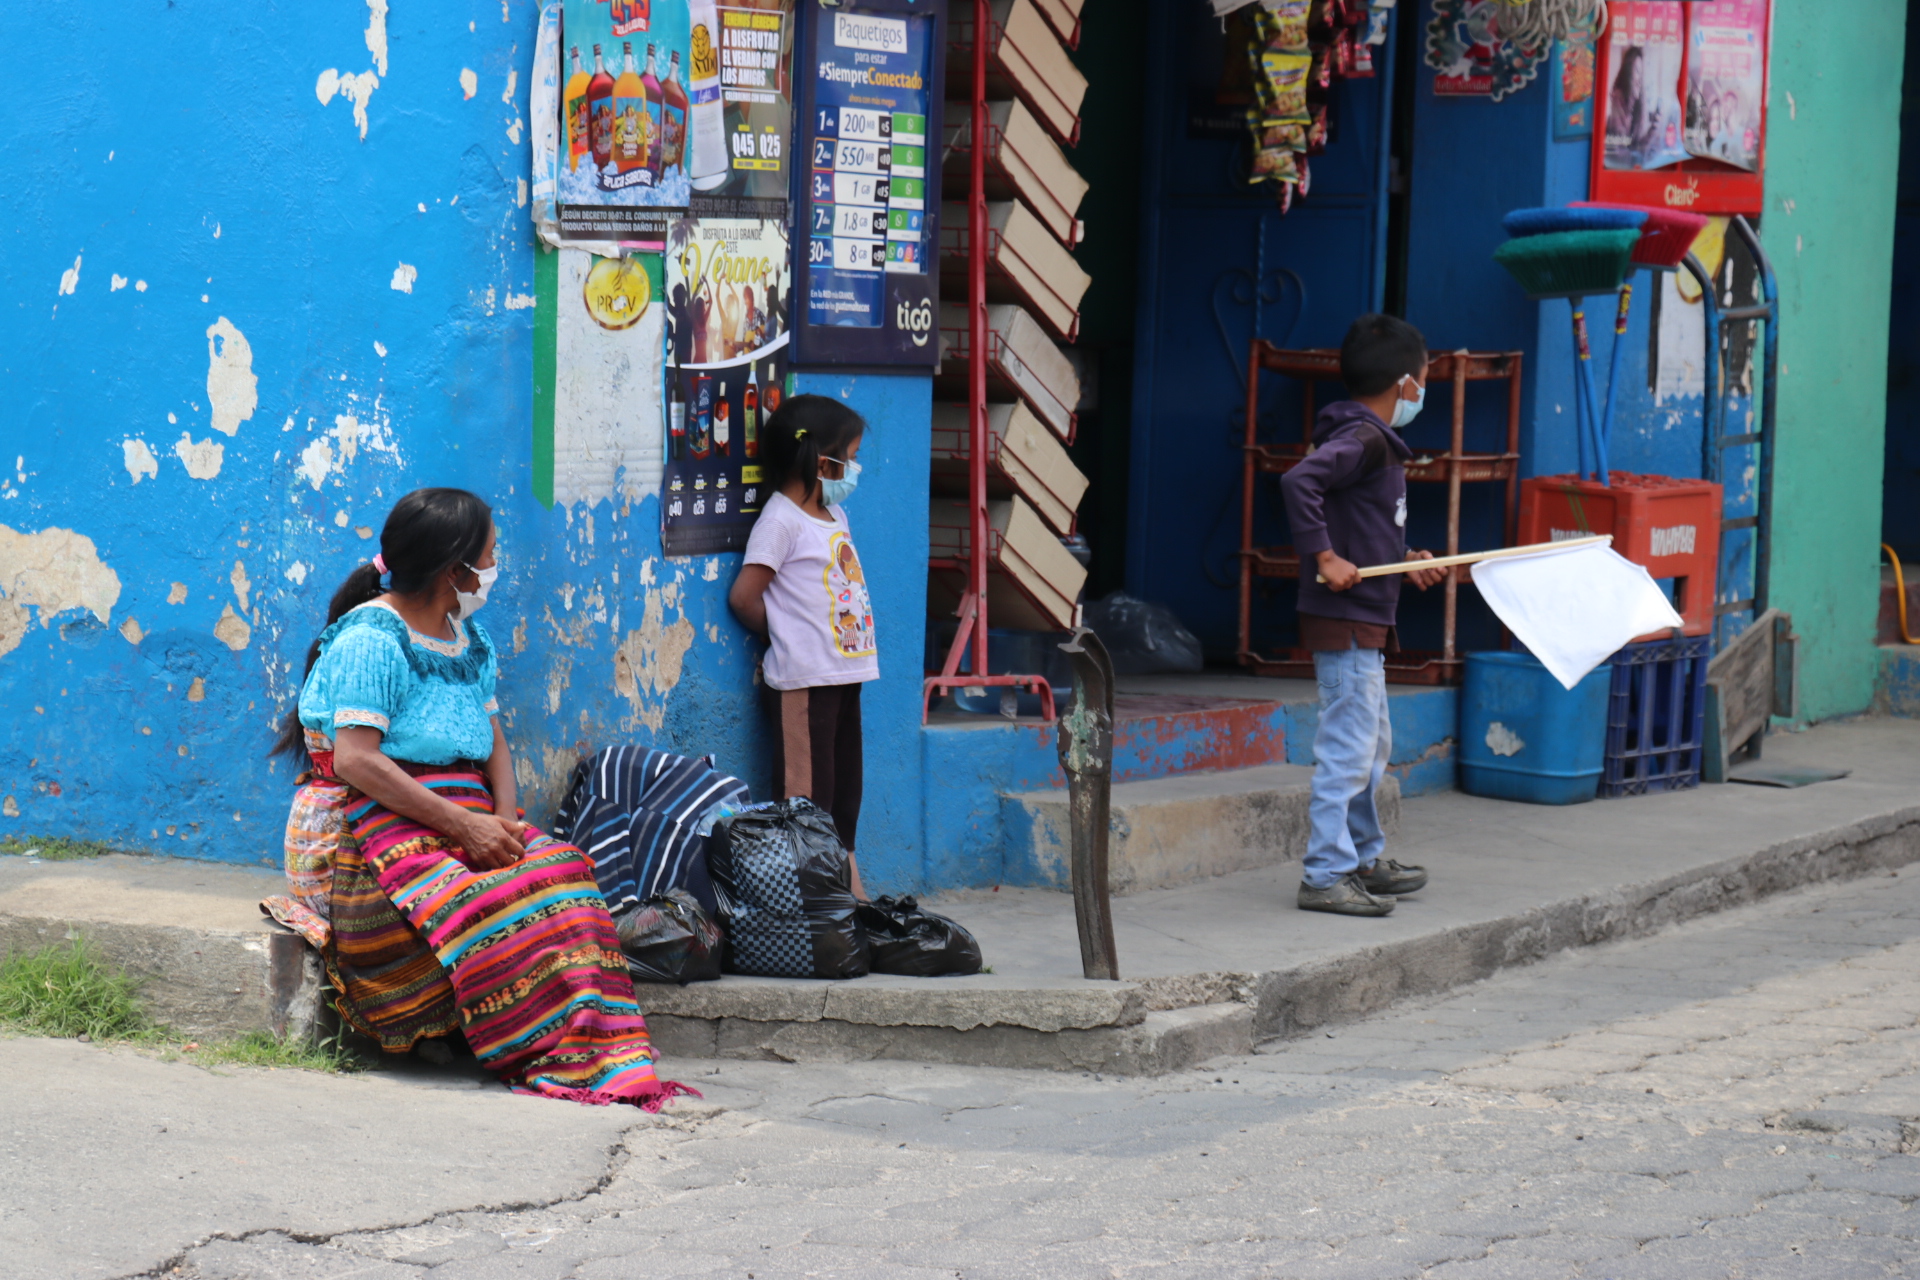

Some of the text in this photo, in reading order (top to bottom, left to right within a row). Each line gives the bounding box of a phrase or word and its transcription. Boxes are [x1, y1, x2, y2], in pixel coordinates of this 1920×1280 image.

[723, 28, 779, 50] A DISFRUTAR
[839, 17, 902, 48] Paquetigos
[722, 49, 777, 69] EL VERANO CON
[854, 52, 888, 65] para estar
[722, 67, 766, 86] LOS AMIGOS
[819, 61, 922, 89] #SiempreConectado
[819, 110, 826, 131] 1
[844, 114, 866, 133] 200
[732, 132, 781, 159] Q45 Q25
[814, 142, 824, 164] 2
[840, 147, 865, 166] 550
[814, 175, 822, 197] 3
[853, 180, 859, 198] 1
[861, 184, 871, 195] GB
[1664, 182, 1695, 206] Claro
[582, 210, 607, 220] DECRETO
[625, 211, 633, 220] EL
[634, 212, 662, 221] CONSUMO
[690, 198, 713, 211] ECRETO
[561, 222, 593, 231] PRODUCTO
[593, 222, 612, 232] CAUSA
[613, 222, 633, 232] SERIOS
[633, 221, 653, 232] DAÑOS
[659, 223, 667, 232] LA
[815, 208, 825, 230] 7
[843, 212, 858, 231] 1.8
[859, 217, 868, 227] GB
[703, 227, 727, 239] DISFRUTA
[733, 228, 739, 239] LO
[740, 228, 762, 240] GRANDE
[726, 241, 738, 253] ESTE
[809, 241, 824, 262] 30
[850, 244, 857, 263] 8
[858, 250, 867, 259] GB
[680, 240, 773, 295] Verano
[668, 498, 727, 517] Q40 Q25 Q55
[1651, 524, 1696, 557] BRAHVA
